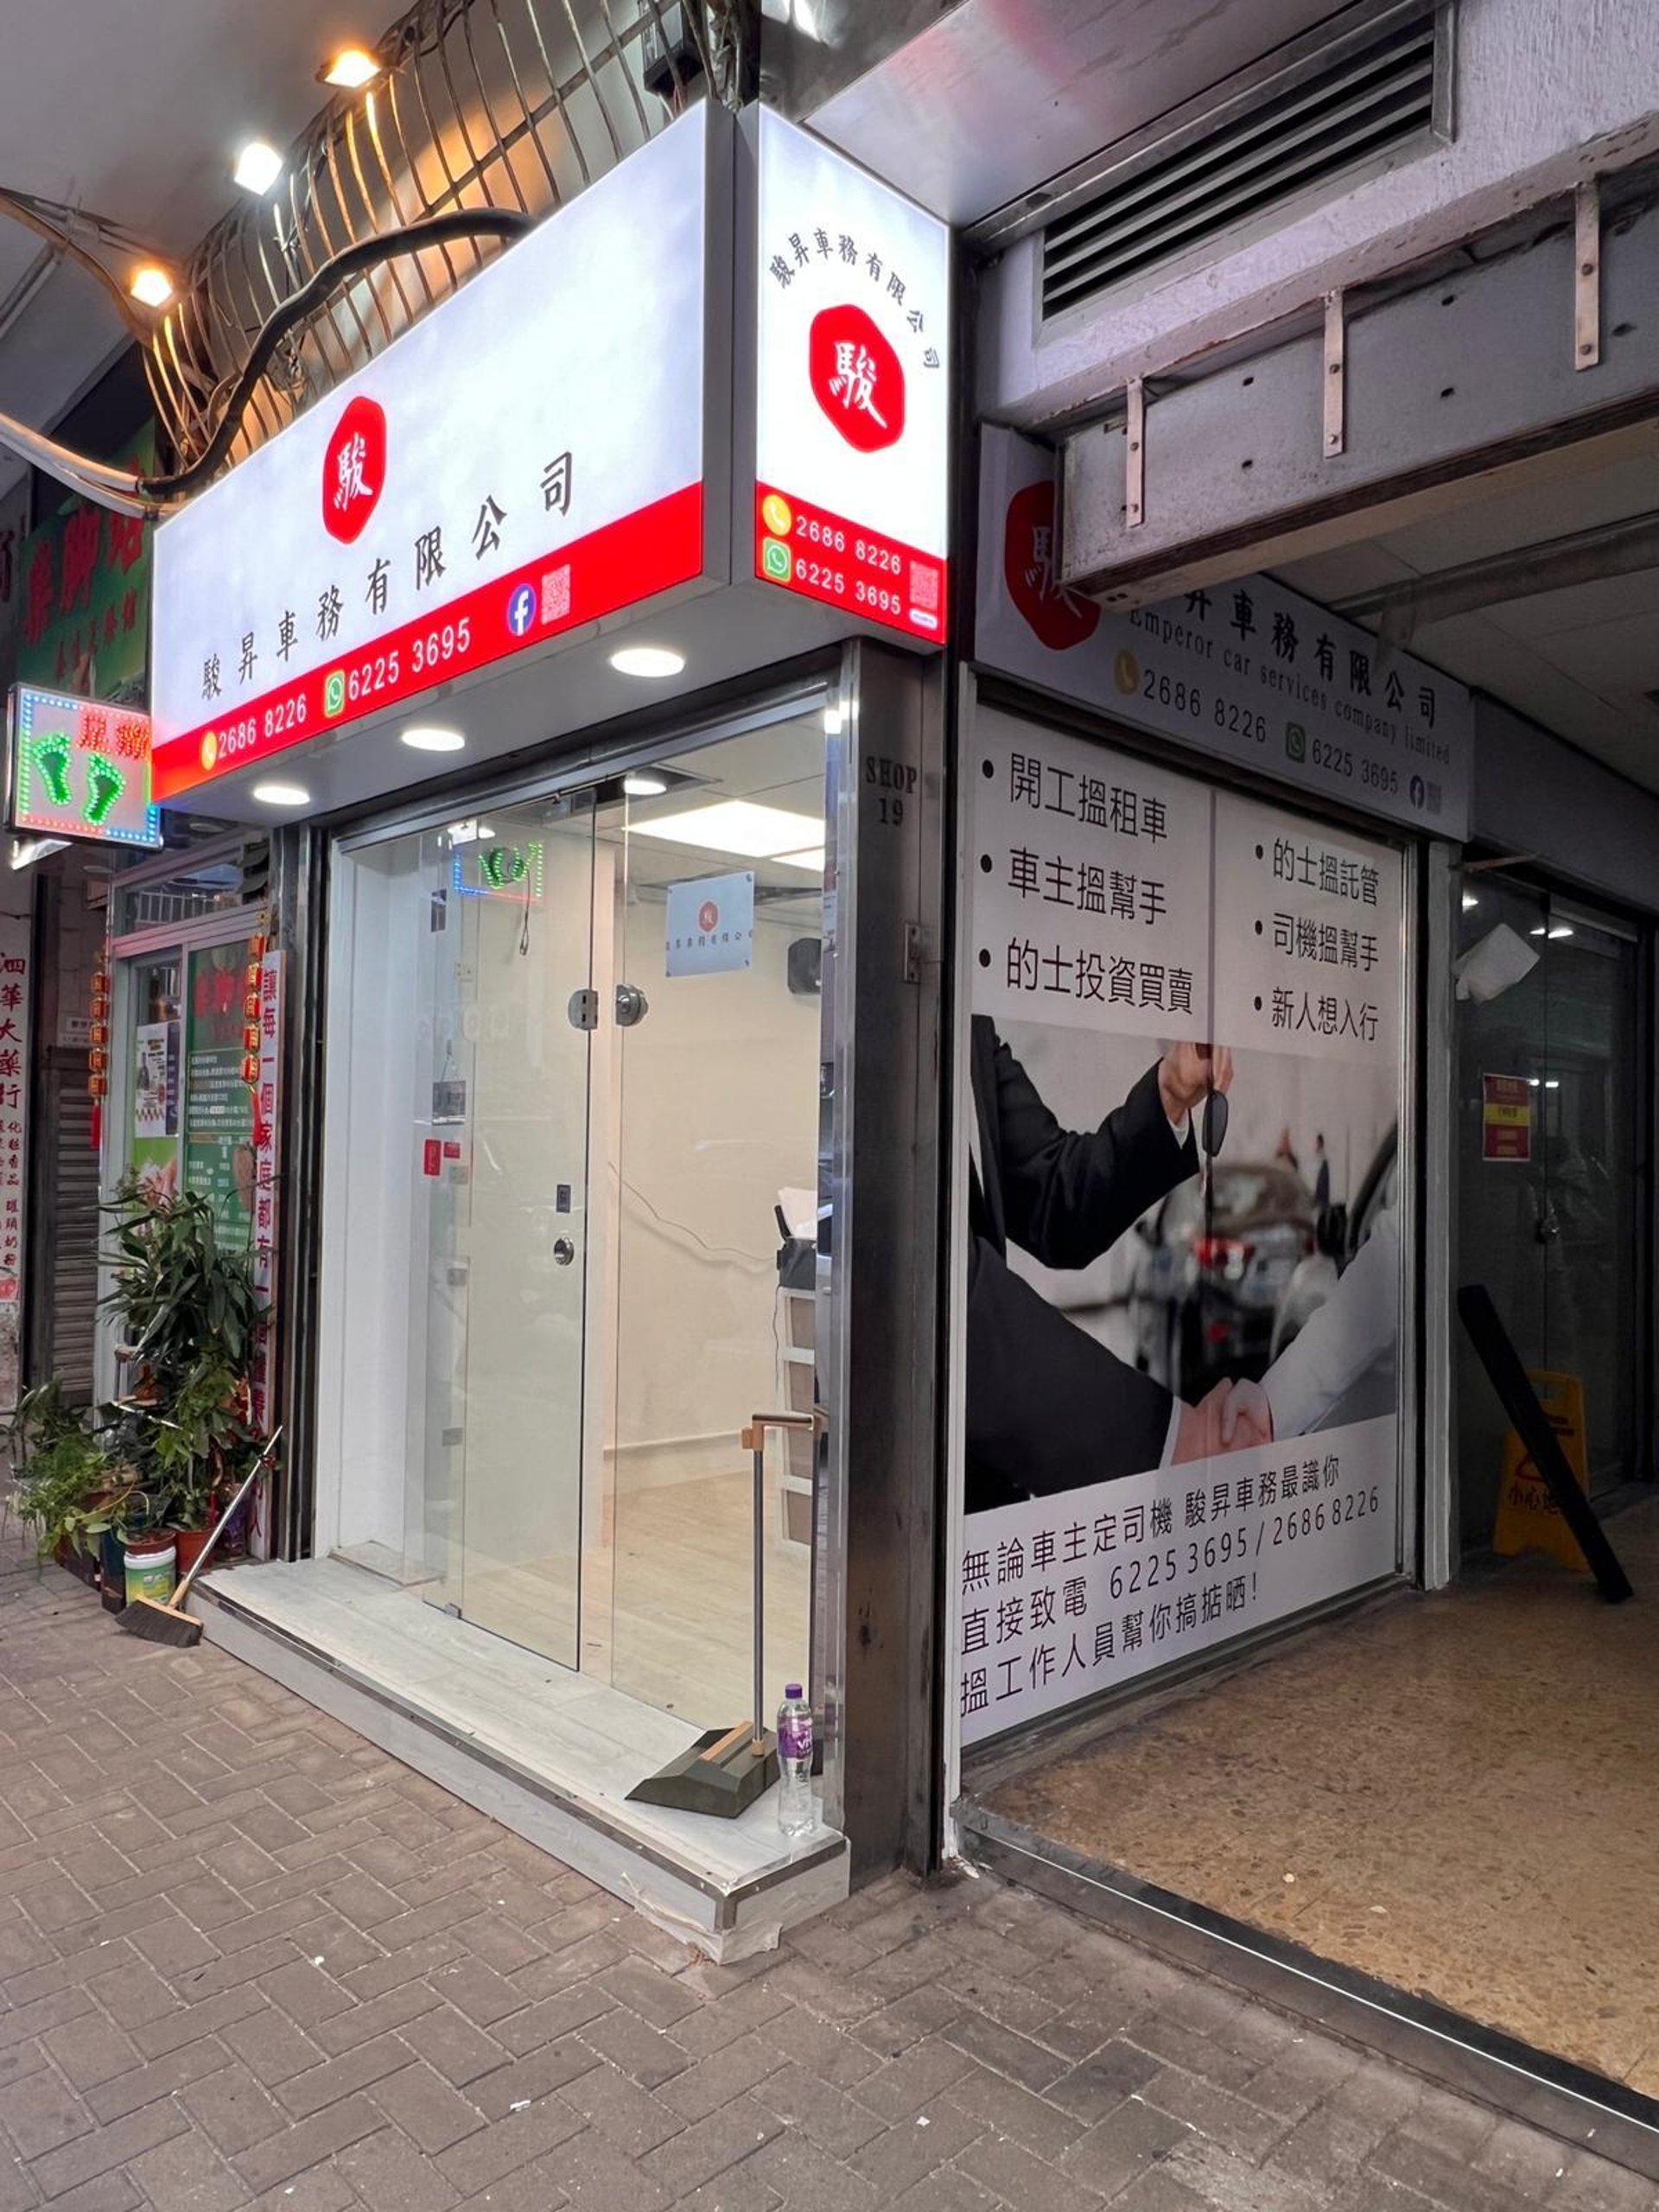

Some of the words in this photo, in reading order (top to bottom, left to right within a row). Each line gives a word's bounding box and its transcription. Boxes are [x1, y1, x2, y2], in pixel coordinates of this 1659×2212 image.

[769, 227, 940, 368] 駿昇車務有限公司
[829, 340, 888, 429] 駿
[334, 432, 373, 511] 駿
[201, 451, 572, 701] 駿昇車務有限公司
[796, 515, 845, 552] 2686
[855, 539, 901, 575] 8226
[796, 558, 845, 594] 6225
[855, 581, 901, 614] 3695
[348, 651, 399, 701] 6225
[412, 618, 471, 673] 3695
[1129, 610, 1213, 658] Emperor
[1224, 649, 1250, 676] car
[1261, 665, 1326, 710] services
[1335, 700, 1395, 745] company
[1406, 724, 1450, 765] limited
[219, 718, 256, 759] 2686
[265, 694, 307, 738] 8226
[1144, 669, 1201, 717] 2686
[1215, 698, 1266, 742] 8226
[866, 755, 917, 794] SHOP
[1011, 753, 1167, 843] 開工搵租車
[1313, 739, 1352, 777] 6225
[1362, 759, 1398, 795] 3695
[879, 798, 904, 826] 19
[1007, 847, 1166, 925] 車主搵幫手
[1273, 837, 1379, 906] 的士搵託管
[1007, 937, 1193, 1015] 的士投資買賣
[1273, 912, 1378, 971] 司機搵幫手
[1271, 986, 1378, 1041] 新人想入行
[962, 1497, 1173, 1596] 無論車主定司機
[1185, 1454, 1339, 1529] 駿昇車務最識你
[961, 1576, 1087, 1656] 直接致電
